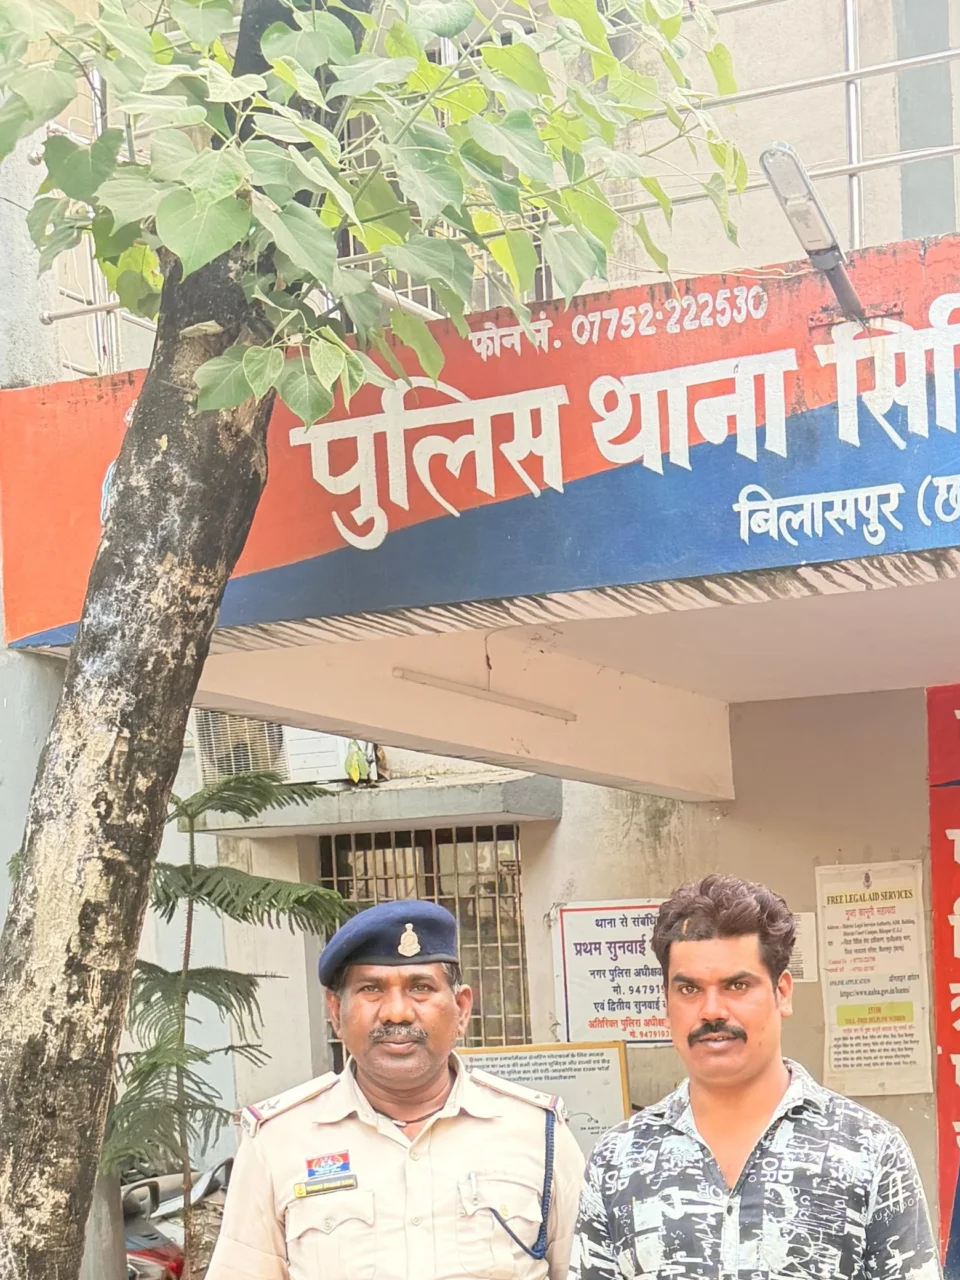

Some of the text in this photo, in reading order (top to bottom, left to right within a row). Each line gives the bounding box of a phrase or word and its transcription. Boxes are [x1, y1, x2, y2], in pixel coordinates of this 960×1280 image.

[469, 321, 522, 362] फोन
[289, 376, 570, 551] पुलिस
[588, 348, 800, 475] थाना
[733, 481, 904, 546] बिलासपुर
[827, 889, 913, 905] FREE LEGAL AID SERVICES
[595, 912, 658, 929] थाना से संबंधि
[573, 933, 646, 962] प्रथम सुनवाई
[589, 969, 606, 979] नगर
[609, 966, 631, 982] पुलिस
[612, 982, 625, 995] मो.
[593, 999, 605, 1013] एवं
[607, 997, 631, 1012] द्वितीय
[633, 996, 660, 1014] सुनवाई
[621, 1016, 642, 1031] पुलिस
